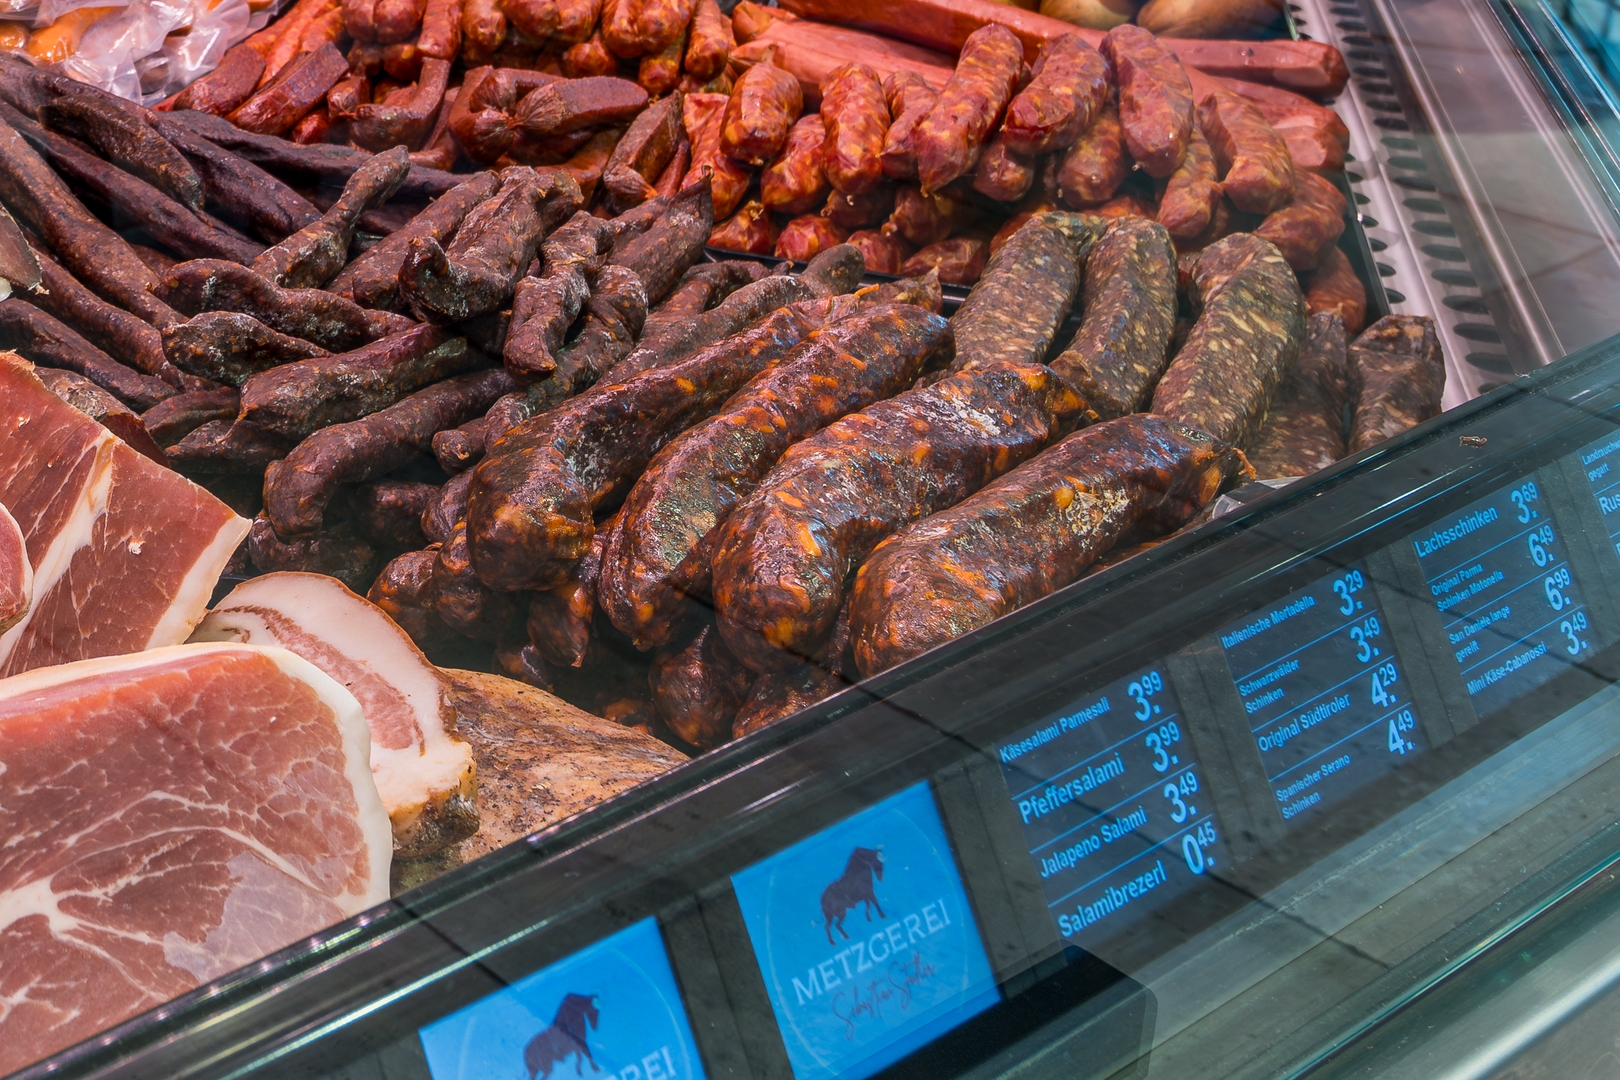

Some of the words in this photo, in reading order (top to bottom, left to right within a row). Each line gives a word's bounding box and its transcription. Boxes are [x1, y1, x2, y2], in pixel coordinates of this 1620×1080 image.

[1589, 462, 1610, 481] gegart
[1414, 507, 1499, 558] Lachsschinken
[1431, 577, 1461, 596] Original
[1459, 564, 1484, 581] Parma
[1436, 589, 1471, 612] Schinken
[1221, 618, 1271, 649] Italienische
[1269, 595, 1316, 624] Mortadella
[1449, 632, 1465, 645] San
[1463, 616, 1491, 636] Daniele
[1489, 606, 1512, 621] lange
[1455, 640, 1480, 663] gereift
[1467, 678, 1487, 696] Mini
[1485, 641, 1548, 686] Käse-Cabanossi
[1239, 659, 1300, 696] Schwarzwälder
[1245, 688, 1284, 713] Schinken
[1258, 718, 1301, 752] Original
[1300, 694, 1351, 729] Südtiroler
[999, 721, 1061, 763] Käsesalami
[1018, 752, 1125, 824] Pfeffersalami
[1276, 771, 1322, 802] Spanischer
[1321, 754, 1351, 777] Serano
[1282, 792, 1321, 819] Schinken
[1041, 834, 1102, 879] Jalapeno
[1100, 805, 1148, 844] Salami
[1058, 860, 1168, 937] Salamibrezerl
[791, 899, 951, 1006] METZGEREI
